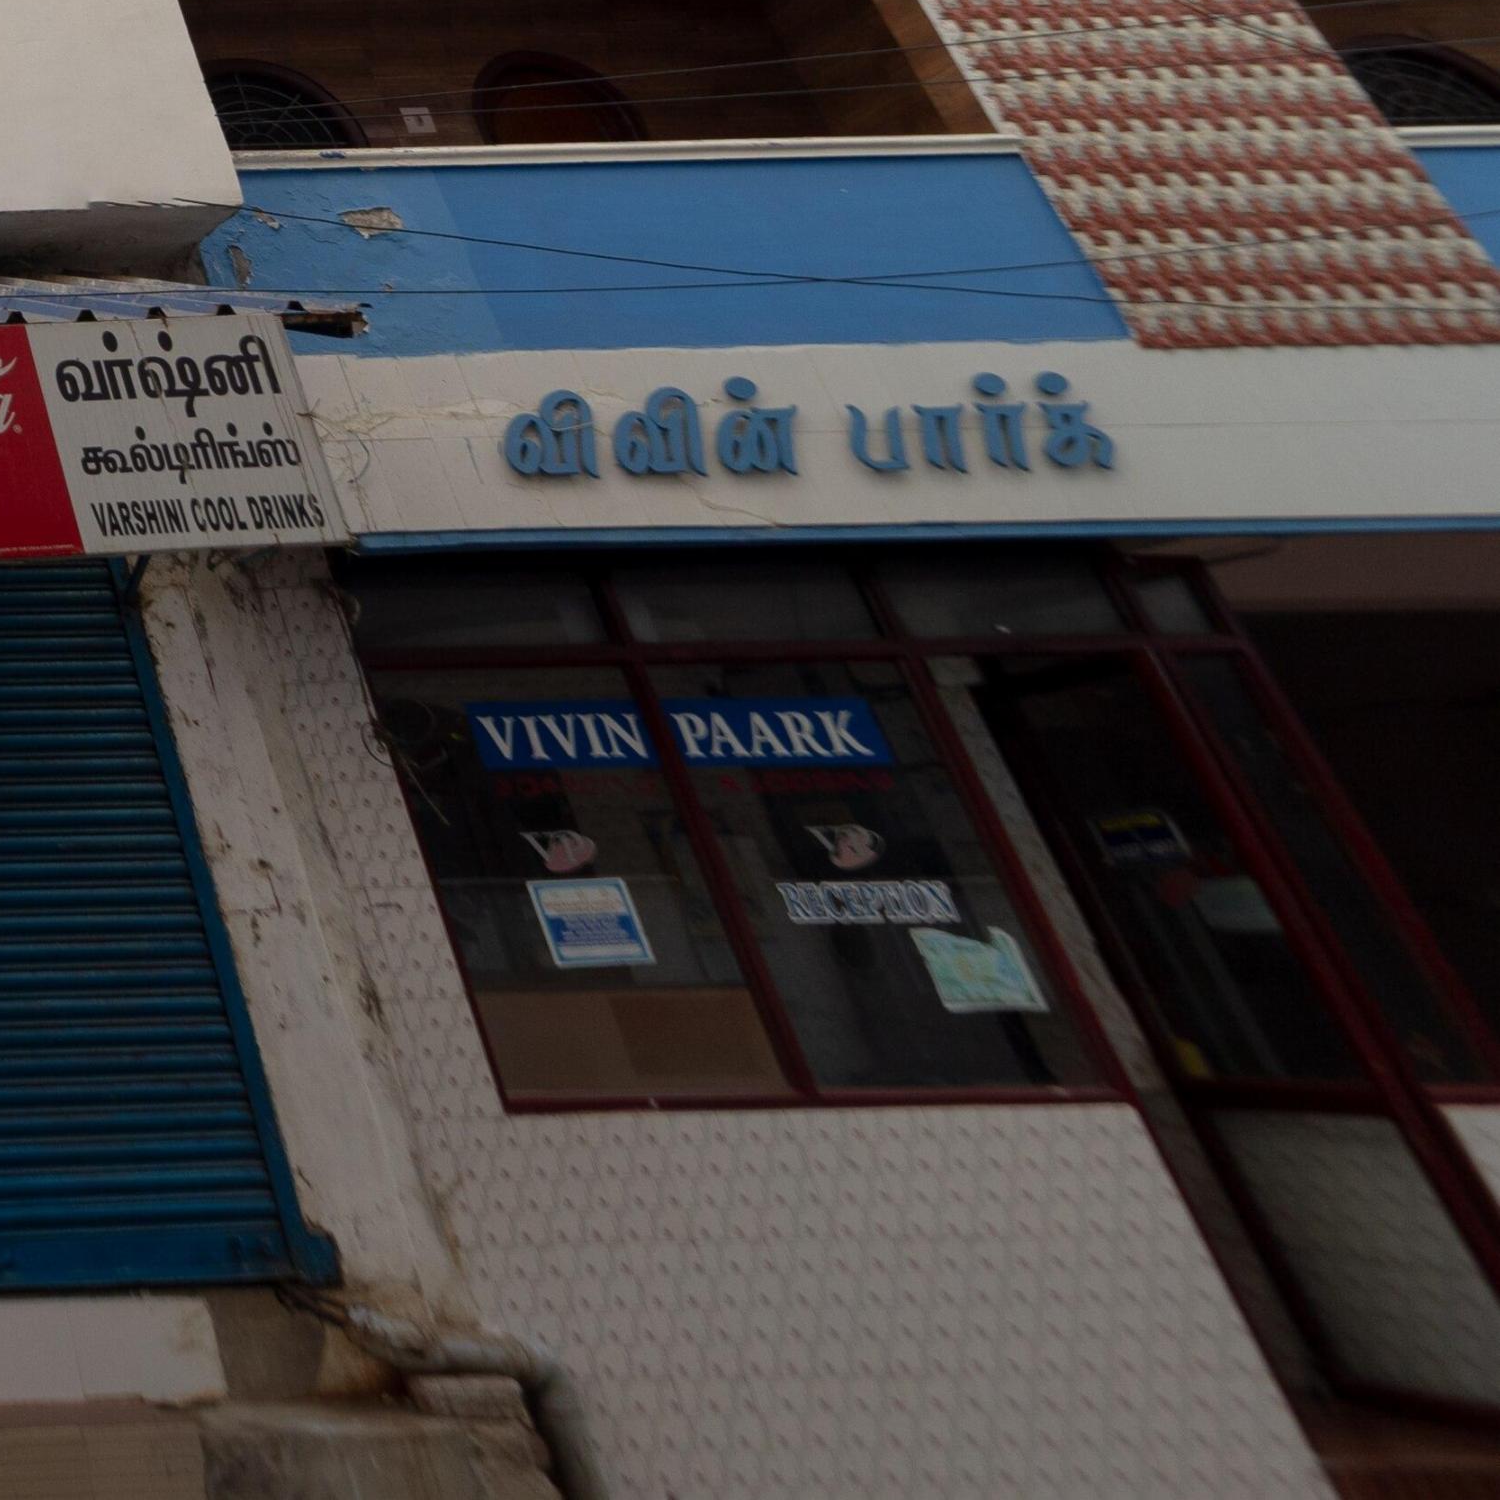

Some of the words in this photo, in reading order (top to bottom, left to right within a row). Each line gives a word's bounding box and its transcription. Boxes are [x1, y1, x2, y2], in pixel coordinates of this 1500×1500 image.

[503, 375, 800, 479] விவின்
[845, 370, 1115, 476] பார்க்
[81, 421, 301, 485] கூல்டிரிங்ஸ்
[91, 498, 191, 538] VARSHINI
[191, 496, 248, 534] COOL
[248, 493, 326, 531] DRINKS
[475, 712, 651, 761] VIVIN
[671, 709, 877, 759] PAARK
[776, 879, 962, 924] RECEPTION
